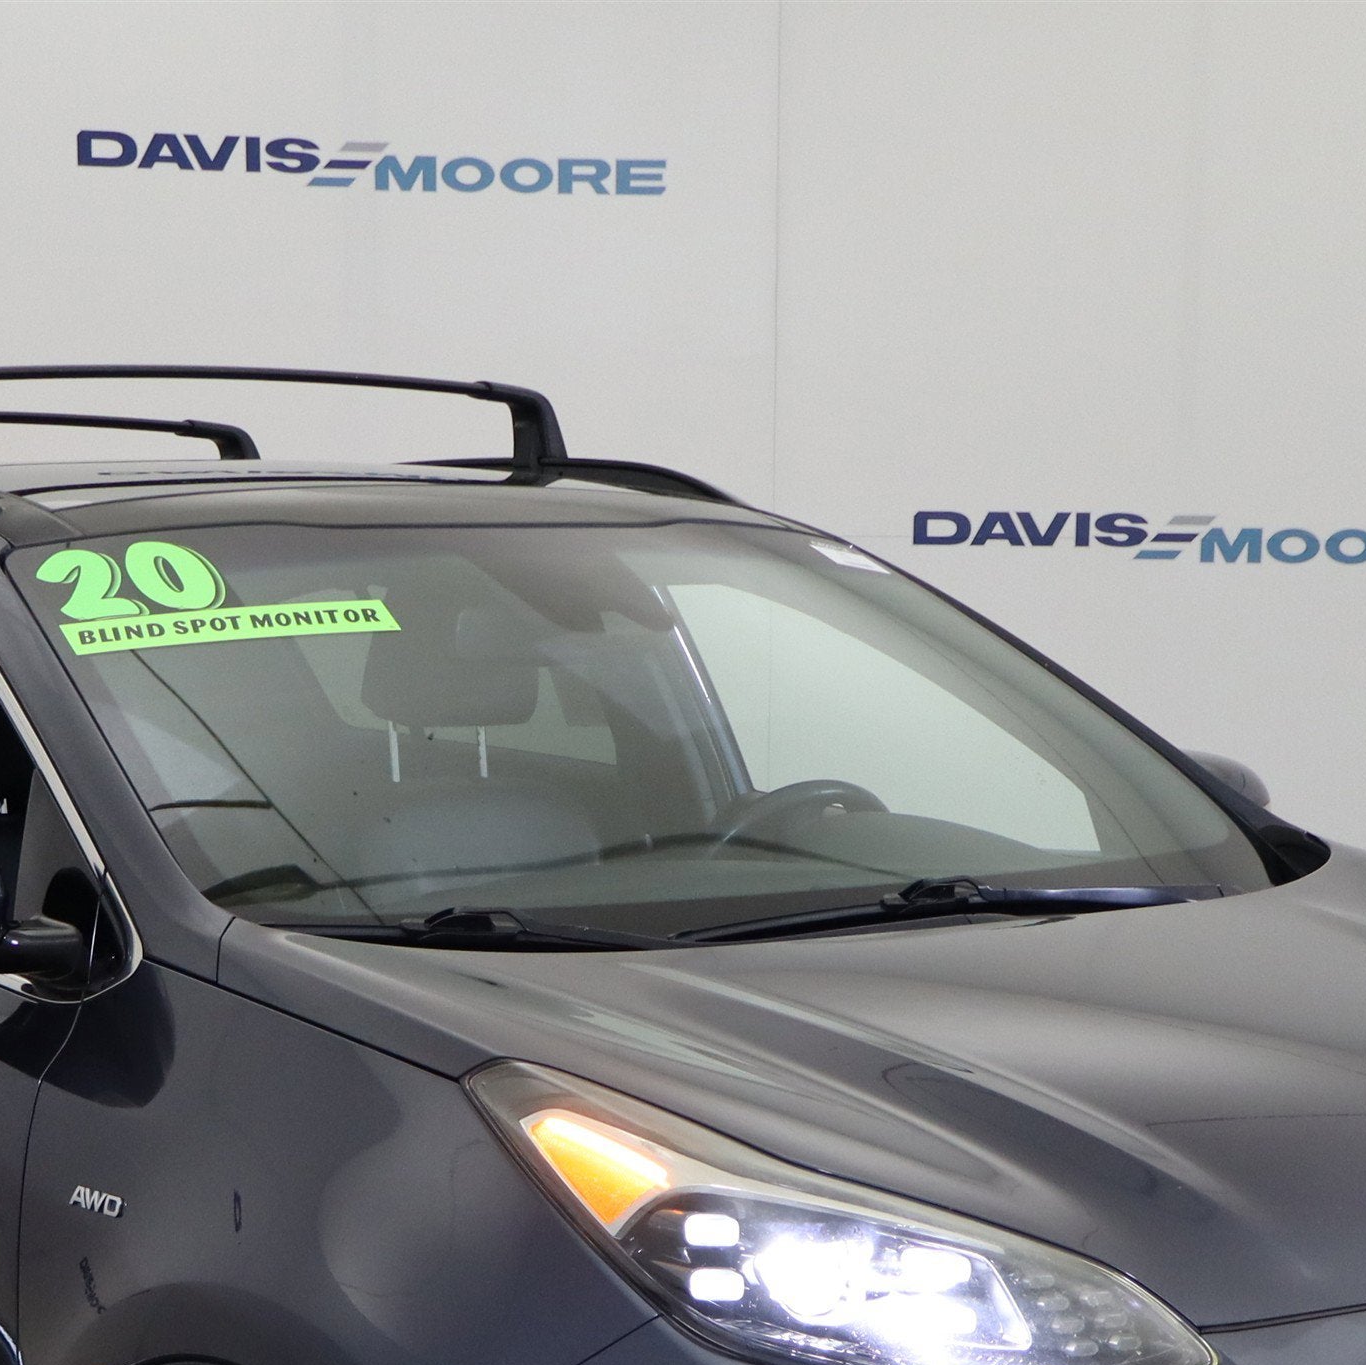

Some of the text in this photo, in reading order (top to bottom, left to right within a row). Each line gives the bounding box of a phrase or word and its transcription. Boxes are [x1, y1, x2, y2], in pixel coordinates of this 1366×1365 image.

[77, 130, 666, 195] DAVIS MOORE
[913, 511, 1148, 547] DAVIS
[36, 541, 226, 621] 20
[78, 608, 380, 645] BLIND SPOT MONITOR
[69, 1185, 123, 1218] AWD
